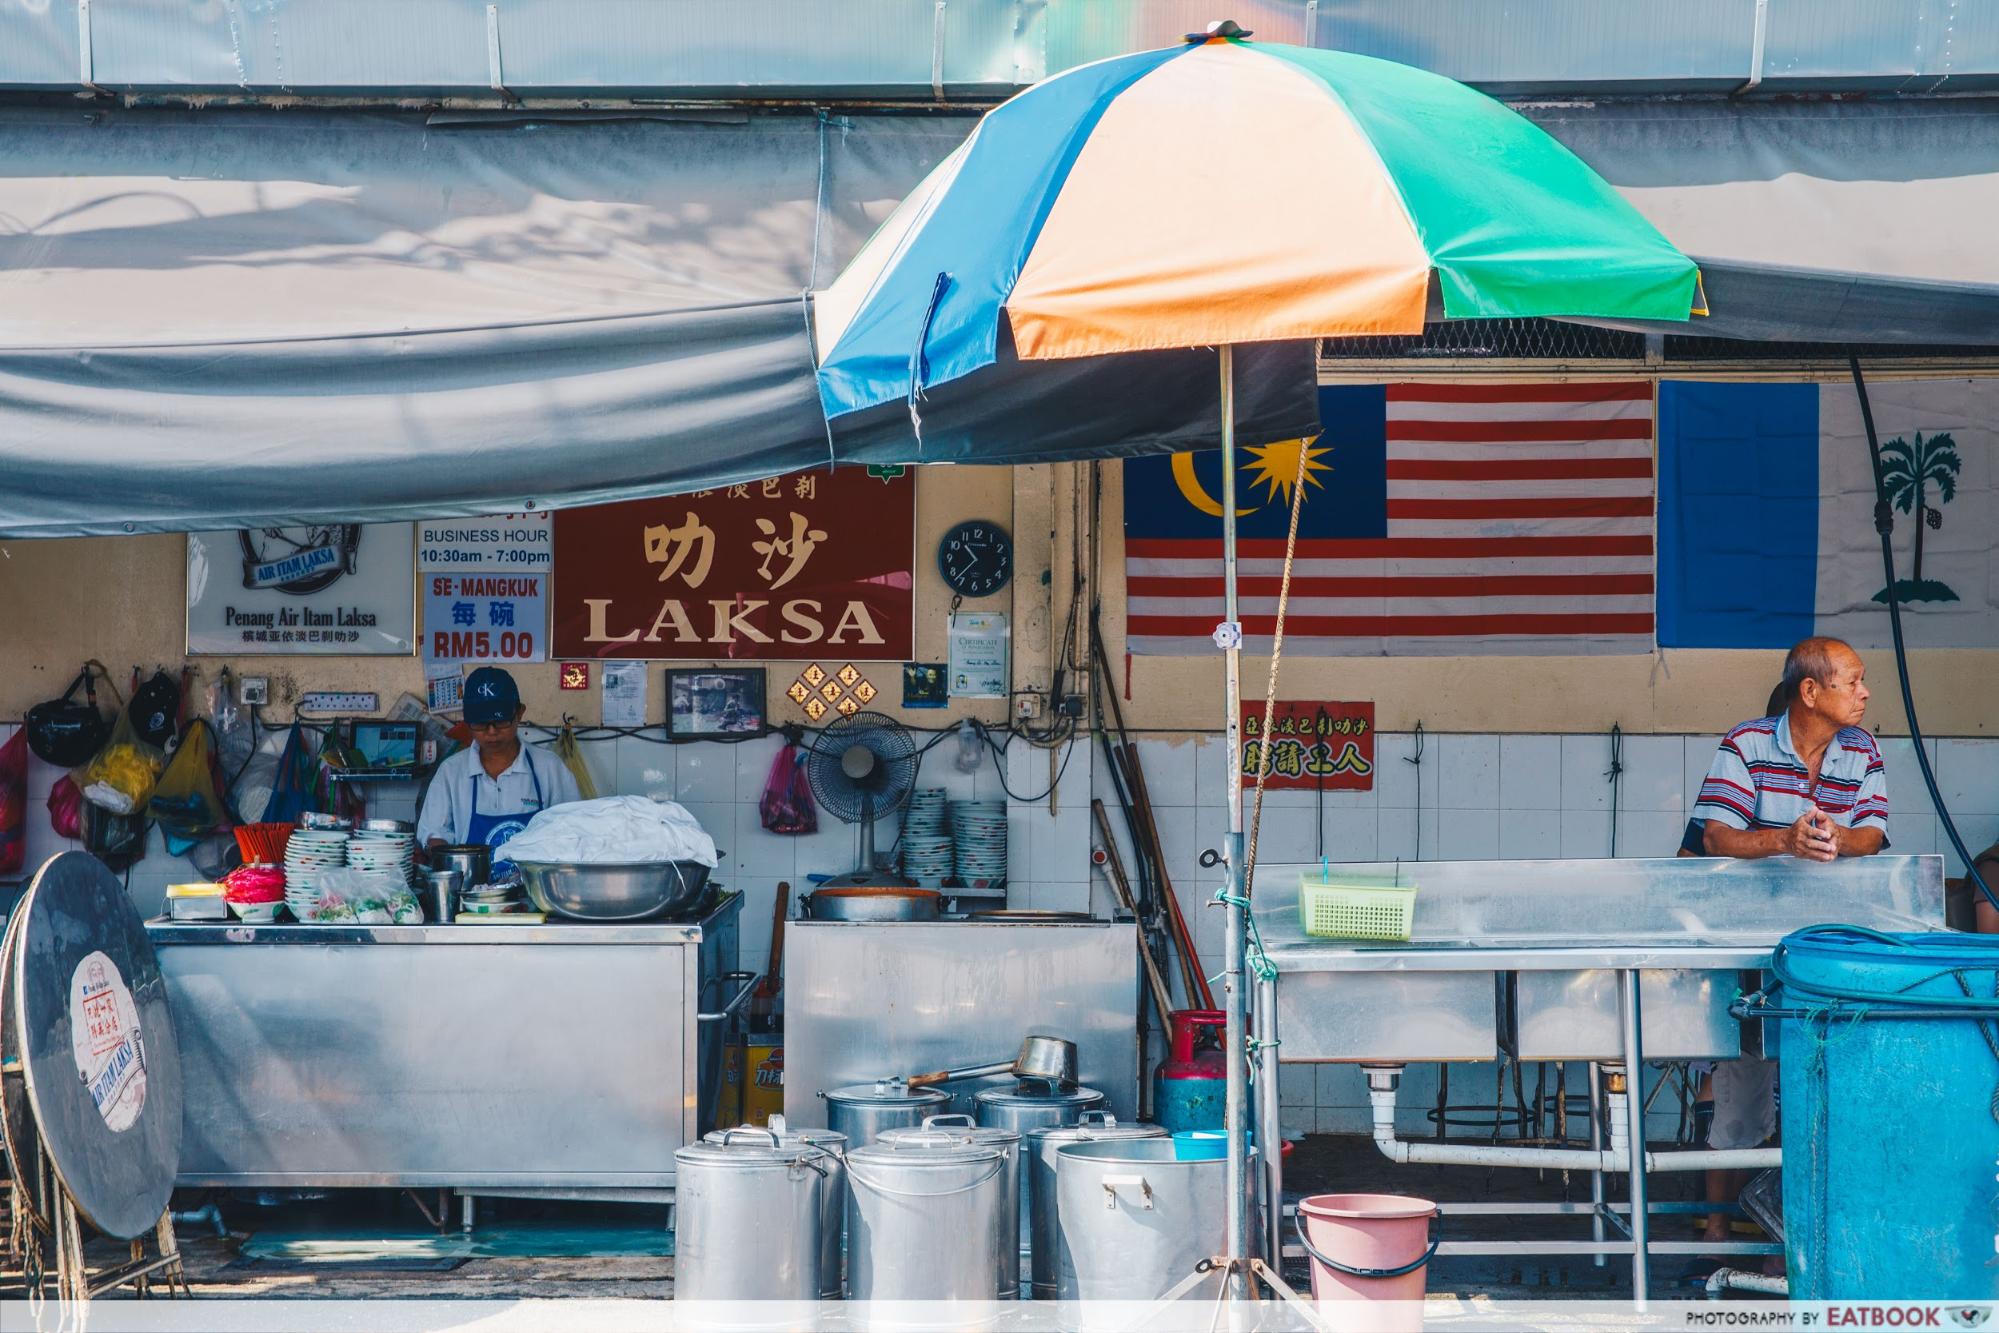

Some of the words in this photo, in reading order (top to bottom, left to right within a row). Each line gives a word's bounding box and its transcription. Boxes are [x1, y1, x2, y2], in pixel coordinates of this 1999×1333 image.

[424, 530, 499, 543] BUSINESS
[504, 530, 549, 543] HOUR
[259, 565, 275, 581] AIR
[277, 556, 302, 577] ITAM
[302, 548, 335, 570] LAKSA
[421, 550, 482, 562] 10:30am
[496, 550, 550, 565] 7:00pm
[644, 511, 828, 591] 叻沙
[226, 606, 274, 629] Penang
[278, 606, 300, 626] Air
[304, 606, 333, 626] Itam
[337, 606, 377, 626] Laksa
[452, 601, 515, 627] 每碗
[583, 599, 886, 645] LAKSA
[434, 631, 533, 659] RM5.00
